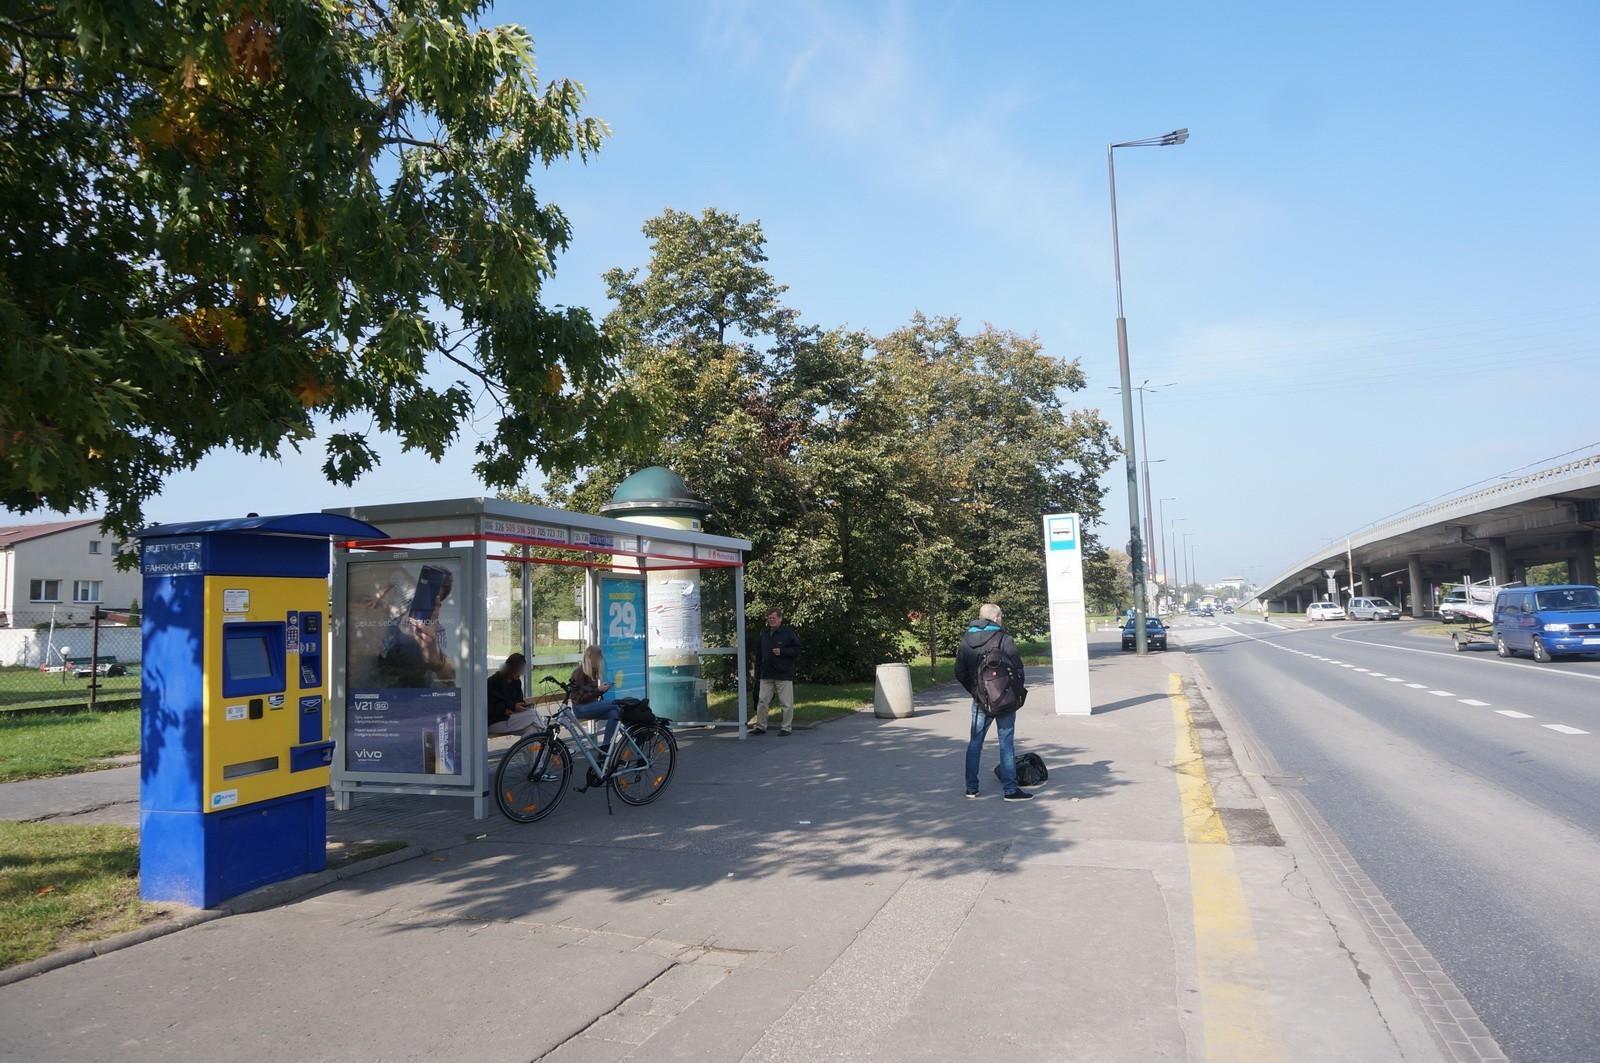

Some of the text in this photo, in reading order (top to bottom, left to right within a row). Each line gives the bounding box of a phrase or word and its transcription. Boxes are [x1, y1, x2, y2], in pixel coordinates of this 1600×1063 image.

[145, 542, 201, 553] BILETY TICKETS
[145, 562, 201, 572] FAHRKARTEN
[609, 602, 637, 637] 29
[354, 701, 373, 711] V21
[355, 748, 382, 759] vivo
